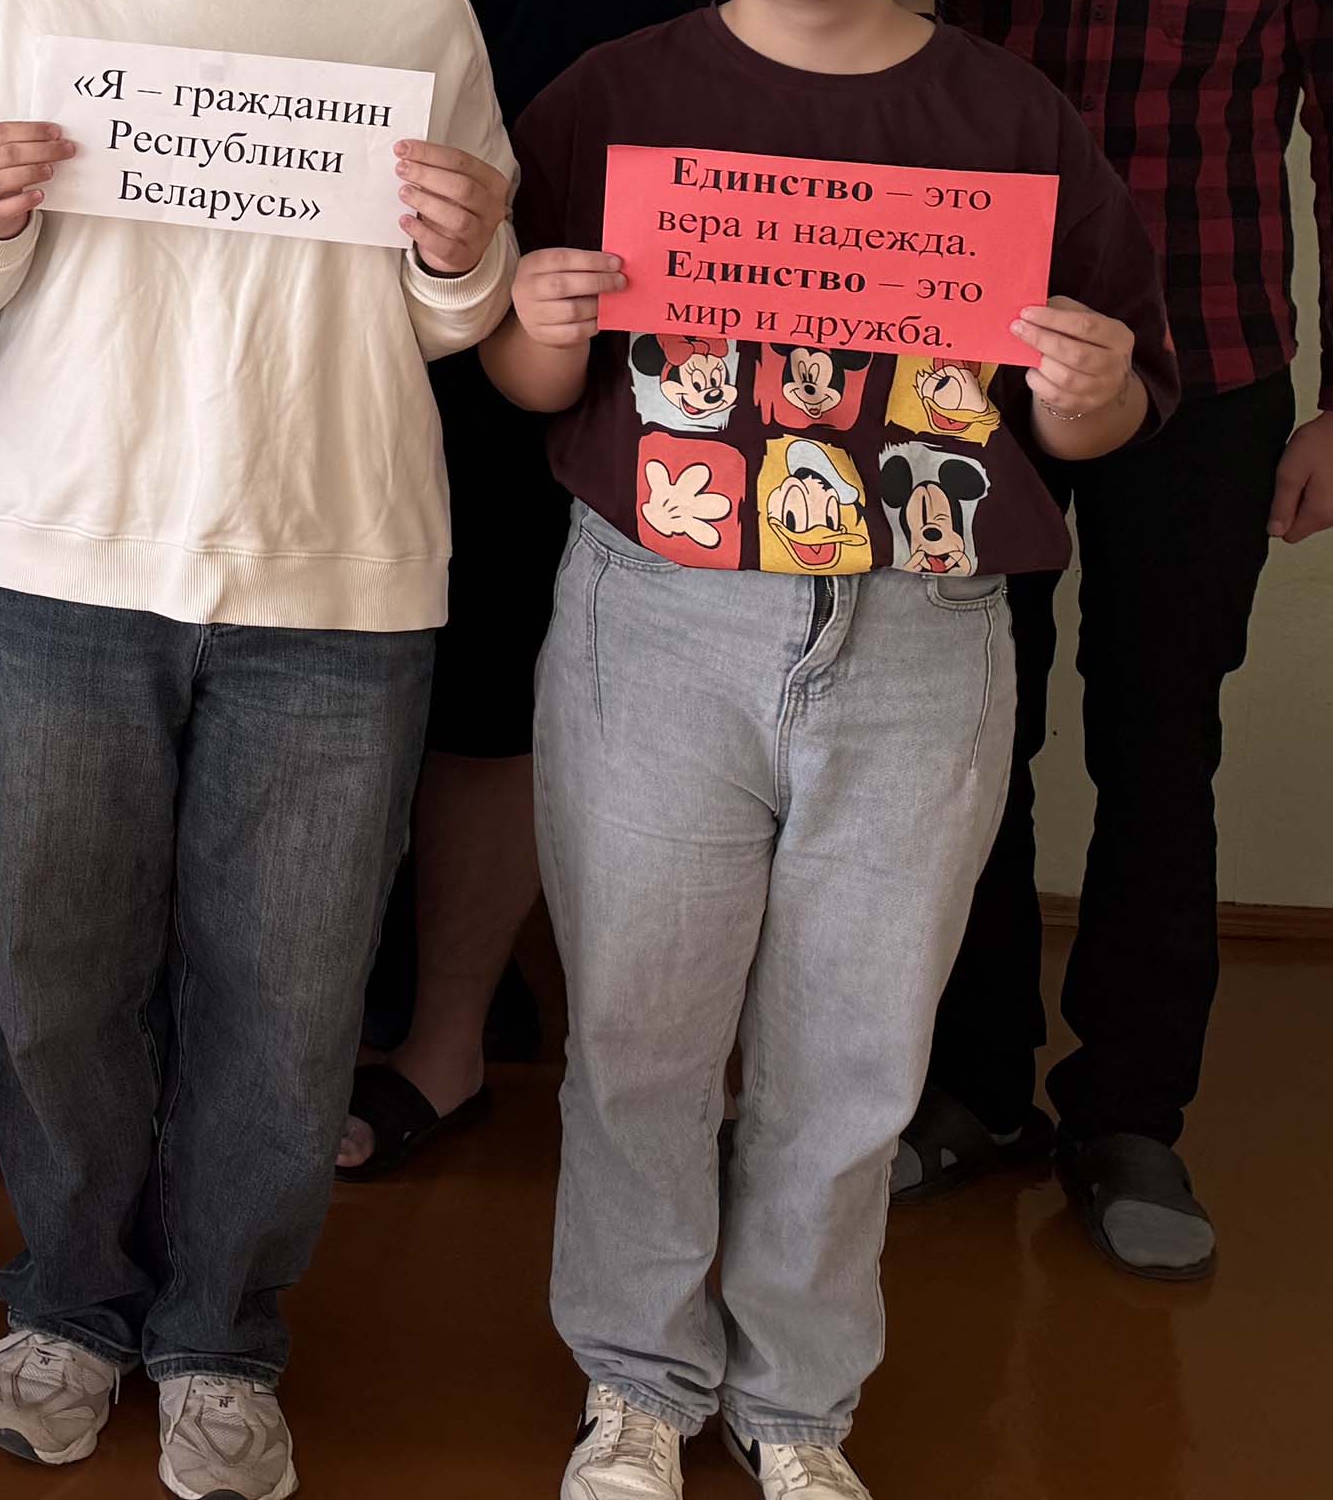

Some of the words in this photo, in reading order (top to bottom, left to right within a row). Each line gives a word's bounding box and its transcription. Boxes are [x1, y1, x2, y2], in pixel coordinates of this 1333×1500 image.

[74, 69, 127, 100] «Я
[173, 84, 393, 127] гражданин
[108, 119, 344, 174] Республики
[118, 170, 321, 221] Беларусь»
[670, 156, 873, 202] Единство
[924, 187, 992, 210] это
[657, 210, 742, 243] вера
[756, 219, 779, 241] и
[794, 222, 976, 257] надежда.
[665, 250, 866, 293] Единство
[916, 278, 983, 303] это
[666, 302, 741, 334] мир
[756, 310, 779, 331] и
[790, 313, 953, 349] дружба.
